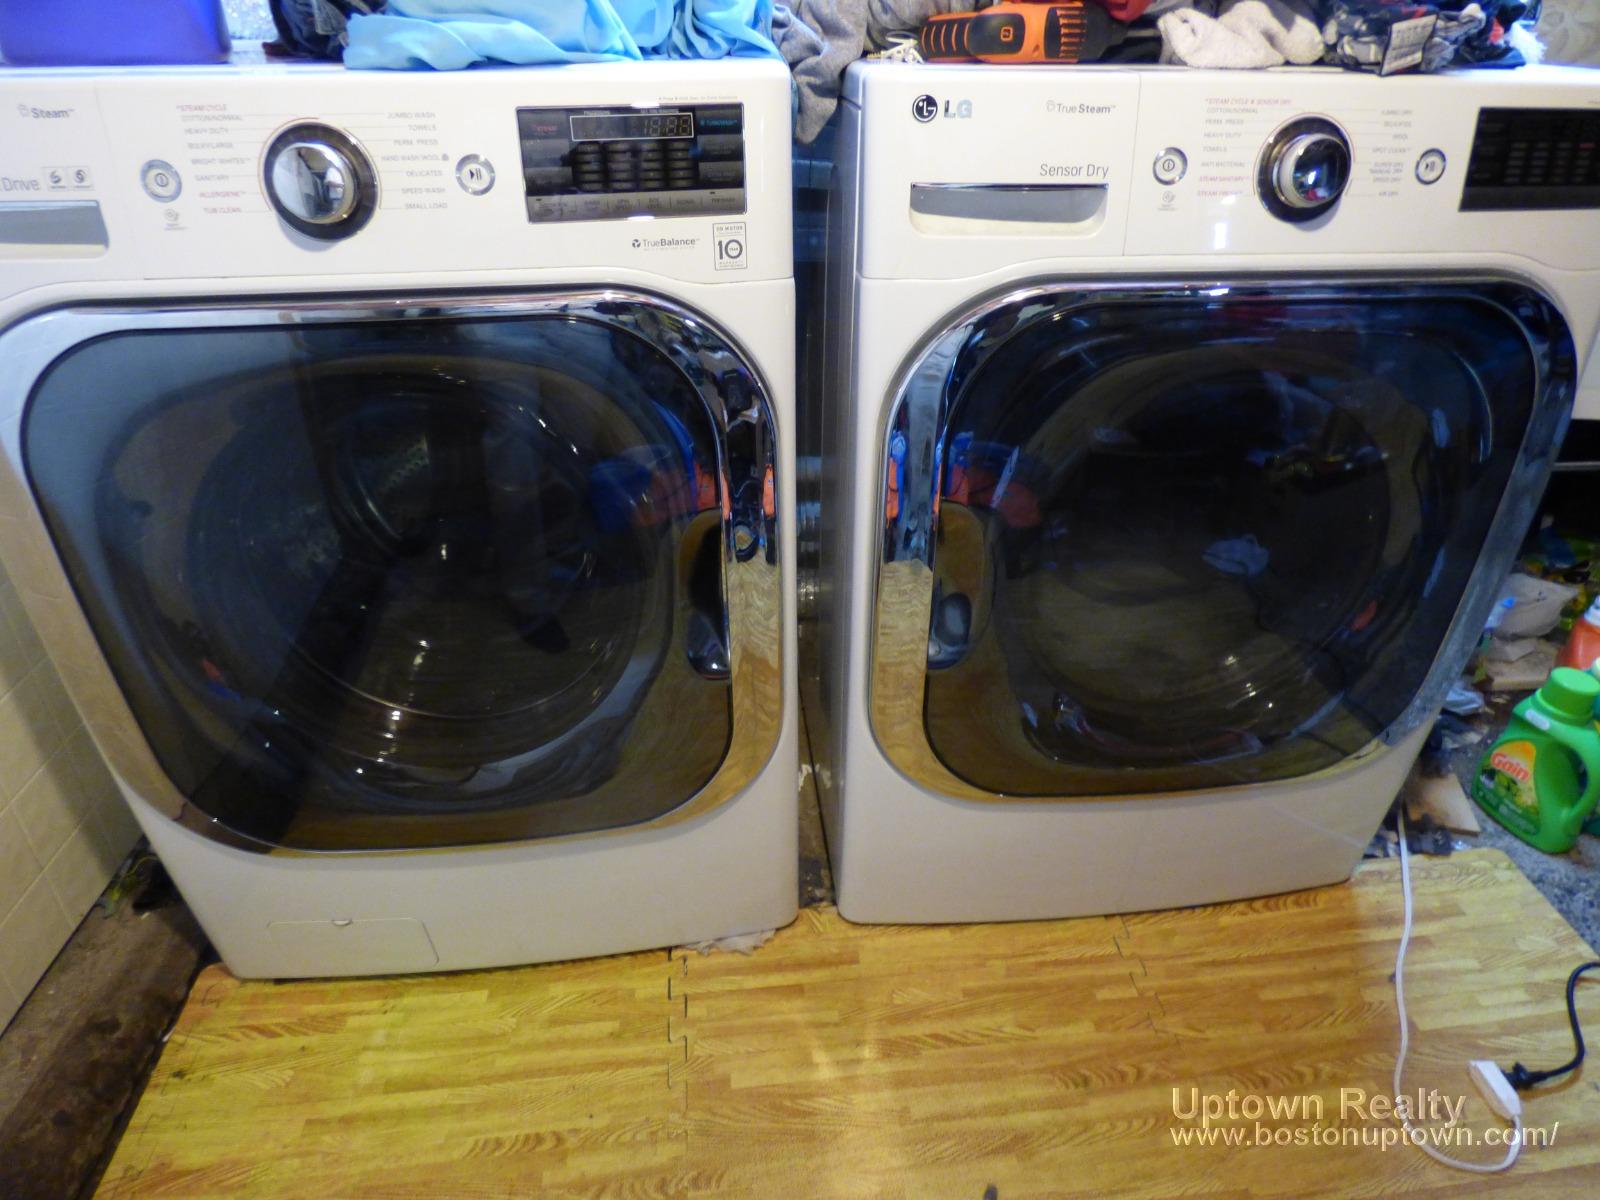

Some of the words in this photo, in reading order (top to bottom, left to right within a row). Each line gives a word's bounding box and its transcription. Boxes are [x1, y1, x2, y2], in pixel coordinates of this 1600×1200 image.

[944, 99, 973, 118] LG
[1039, 163, 1084, 177] Sensor
[1086, 163, 1110, 178] Dry
[1, 177, 41, 191] Drive
[717, 239, 744, 260] 10
[1490, 752, 1531, 782] Gain
